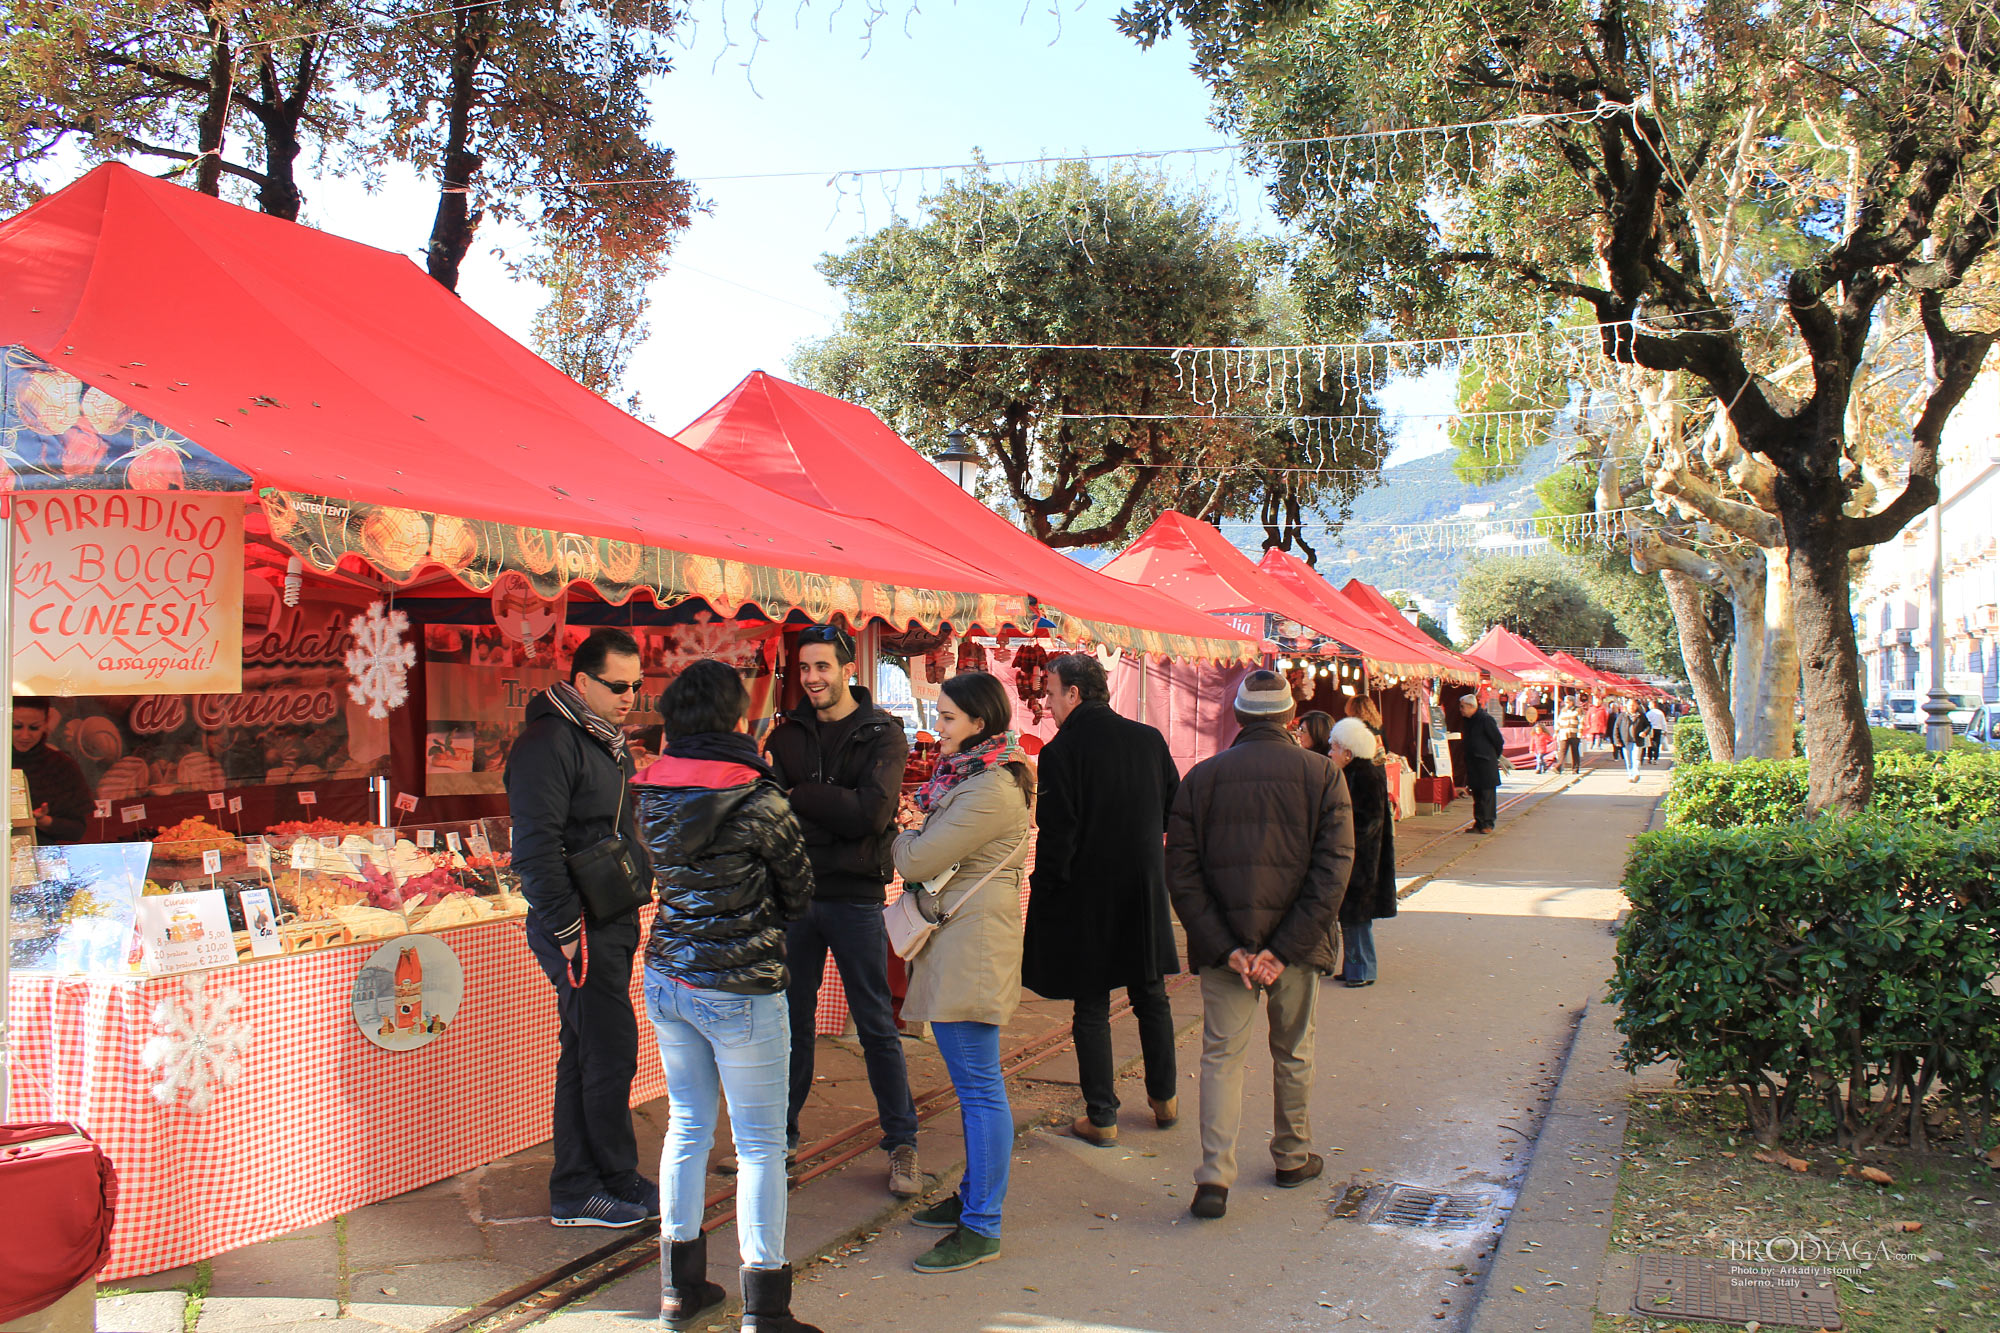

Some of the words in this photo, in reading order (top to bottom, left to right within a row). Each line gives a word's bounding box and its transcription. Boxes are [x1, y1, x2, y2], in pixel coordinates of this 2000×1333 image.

[16, 494, 226, 550] PARADISO
[14, 551, 52, 585] in
[70, 544, 215, 588] BOCCA
[29, 602, 196, 637] CUNEESI
[154, 951, 165, 959] 20
[197, 945, 203, 953] €
[205, 943, 228, 953] 10,00
[208, 955, 230, 964] 22,00
